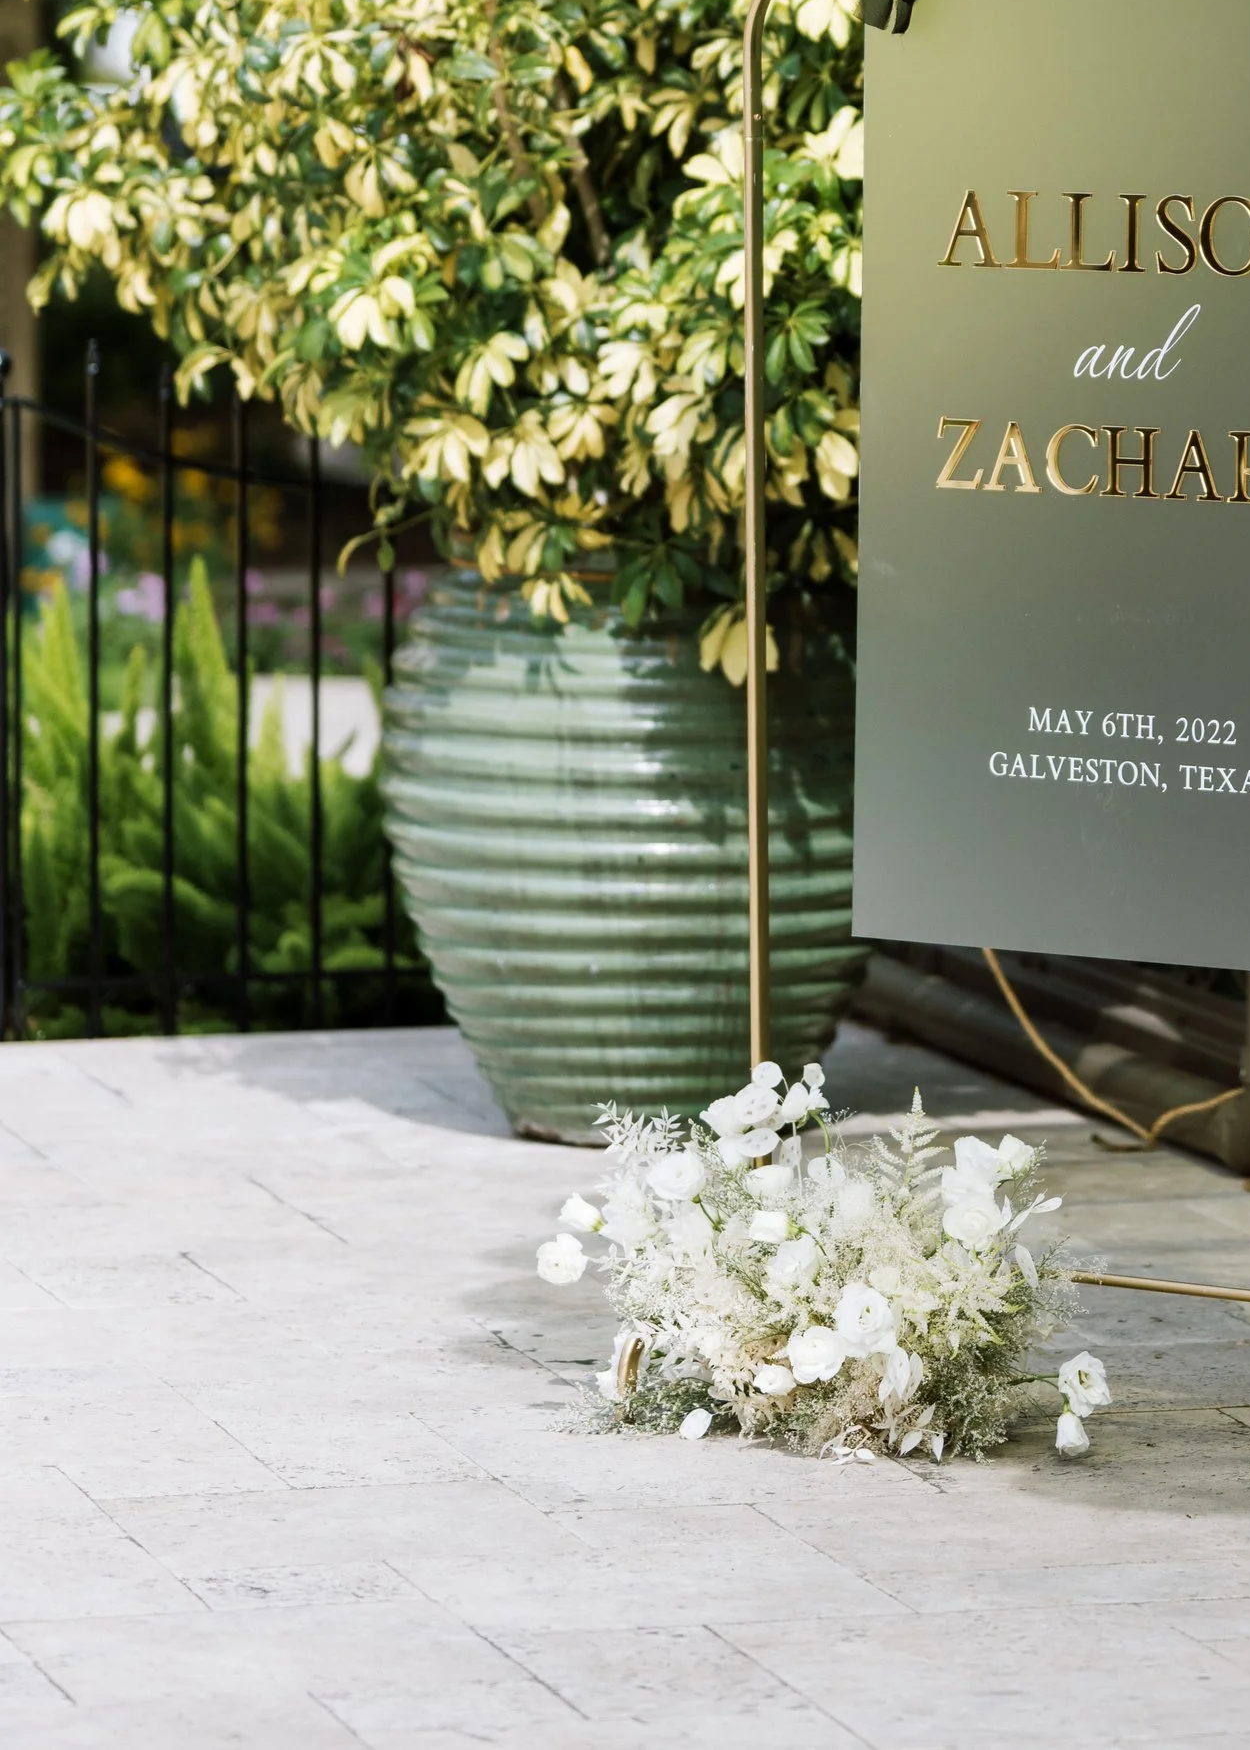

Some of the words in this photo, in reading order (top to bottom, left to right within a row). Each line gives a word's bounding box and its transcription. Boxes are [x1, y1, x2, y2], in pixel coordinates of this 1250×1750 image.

[1073, 304, 1201, 380] and
[1028, 706, 1093, 735] MAY
[1102, 712, 1164, 745] 6TH,
[1175, 717, 1237, 745] 2022
[989, 751, 1167, 793] GALVESTON,
